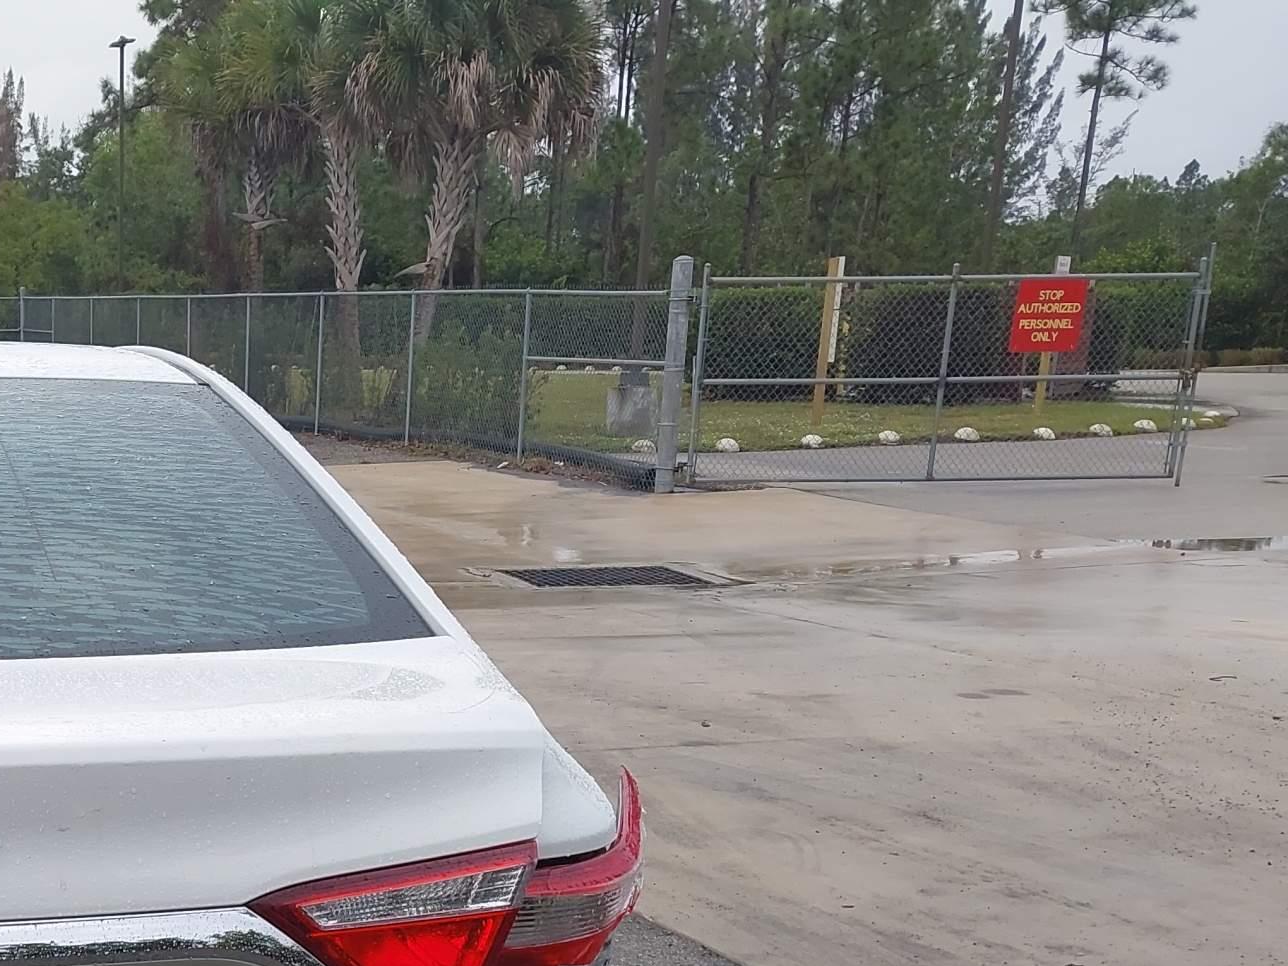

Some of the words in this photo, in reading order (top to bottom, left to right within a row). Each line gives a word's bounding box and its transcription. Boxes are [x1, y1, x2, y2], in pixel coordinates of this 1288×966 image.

[1039, 290, 1064, 300] STOP
[1017, 303, 1081, 313] AUTHORIZED
[1019, 319, 1074, 329] PERSONNEL
[1031, 332, 1059, 342] ONLY
